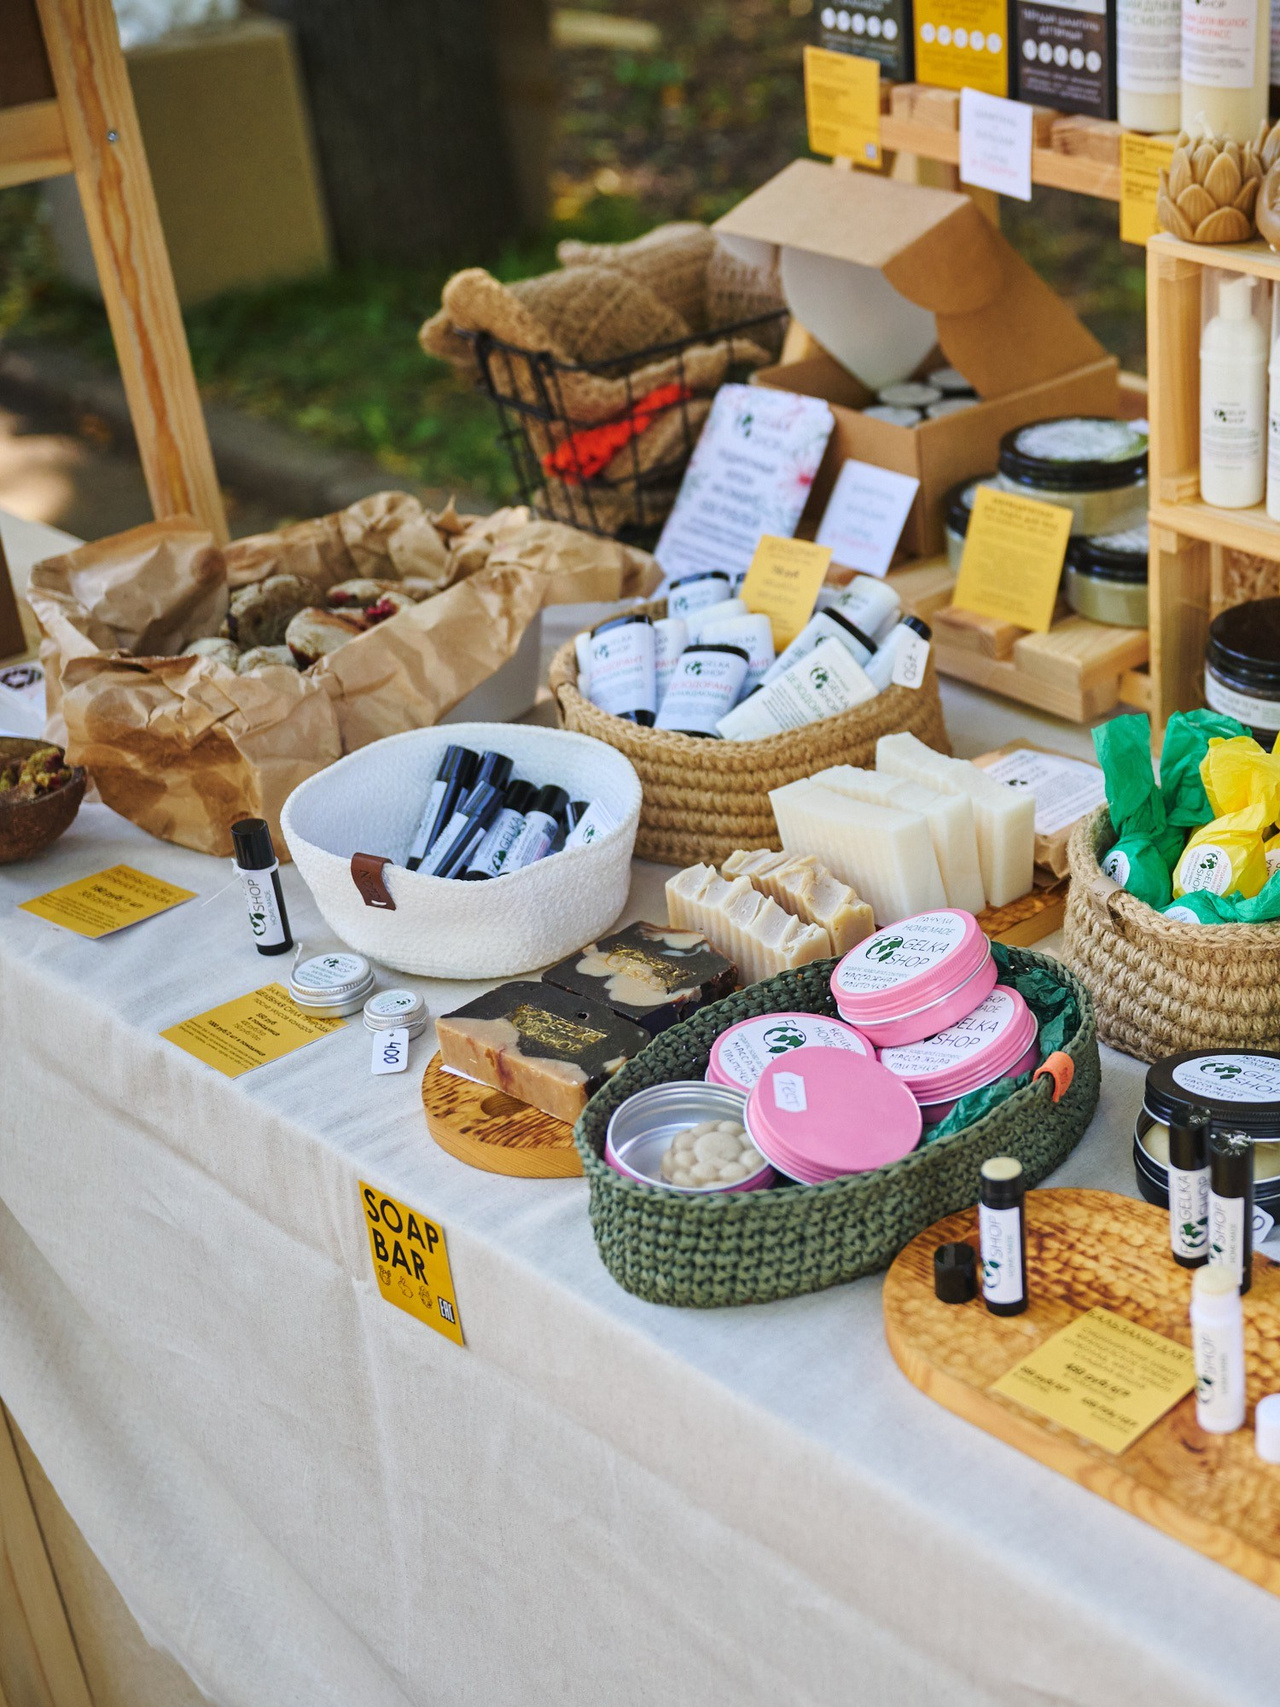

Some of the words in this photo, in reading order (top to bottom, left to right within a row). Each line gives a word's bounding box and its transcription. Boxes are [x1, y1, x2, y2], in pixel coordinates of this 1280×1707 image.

[248, 878, 265, 913] SHOP
[915, 916, 954, 925] ПАЧУЛИ
[884, 953, 930, 968] SHOP
[842, 972, 898, 983] МАССАЖНАЯ
[842, 980, 887, 989] ПЛИТОЧКА
[284, 1005, 302, 1018] СИЛА
[932, 1033, 981, 1049] SHOP
[382, 1042, 402, 1066] 400
[891, 1062, 939, 1071] ПЛИТОЧКА
[363, 1188, 439, 1254] SOAP
[1215, 1201, 1229, 1245] SHOP
[988, 1215, 1003, 1258] SHOP
[372, 1227, 429, 1286] BAR
[1087, 1310, 1155, 1347] БАЛЬЗАМЫ
[1155, 1343, 1186, 1361] ДЛЯ
